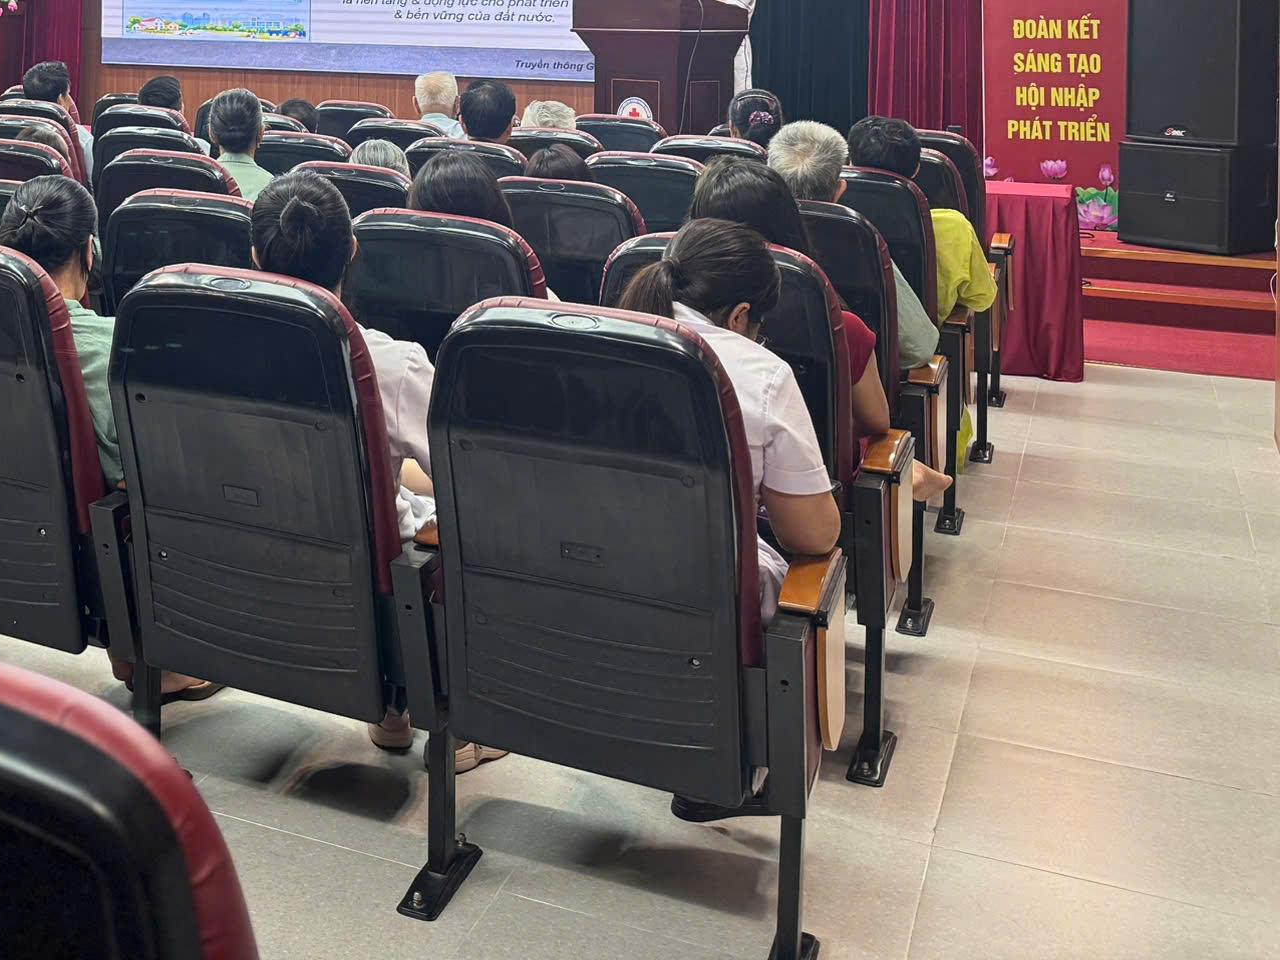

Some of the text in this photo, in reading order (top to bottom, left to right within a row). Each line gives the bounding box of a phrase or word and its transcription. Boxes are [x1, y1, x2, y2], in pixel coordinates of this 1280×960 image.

[394, 7, 555, 23] & bền vững của đất nước.
[1012, 13, 1101, 40] ĐOÀN KẾT
[553, 61, 584, 72] thông
[1013, 49, 1102, 78] SÁNG TẠO
[1015, 83, 1101, 112] HỘI NHẬP
[1007, 113, 1110, 143] PHÁT TRIỂN
